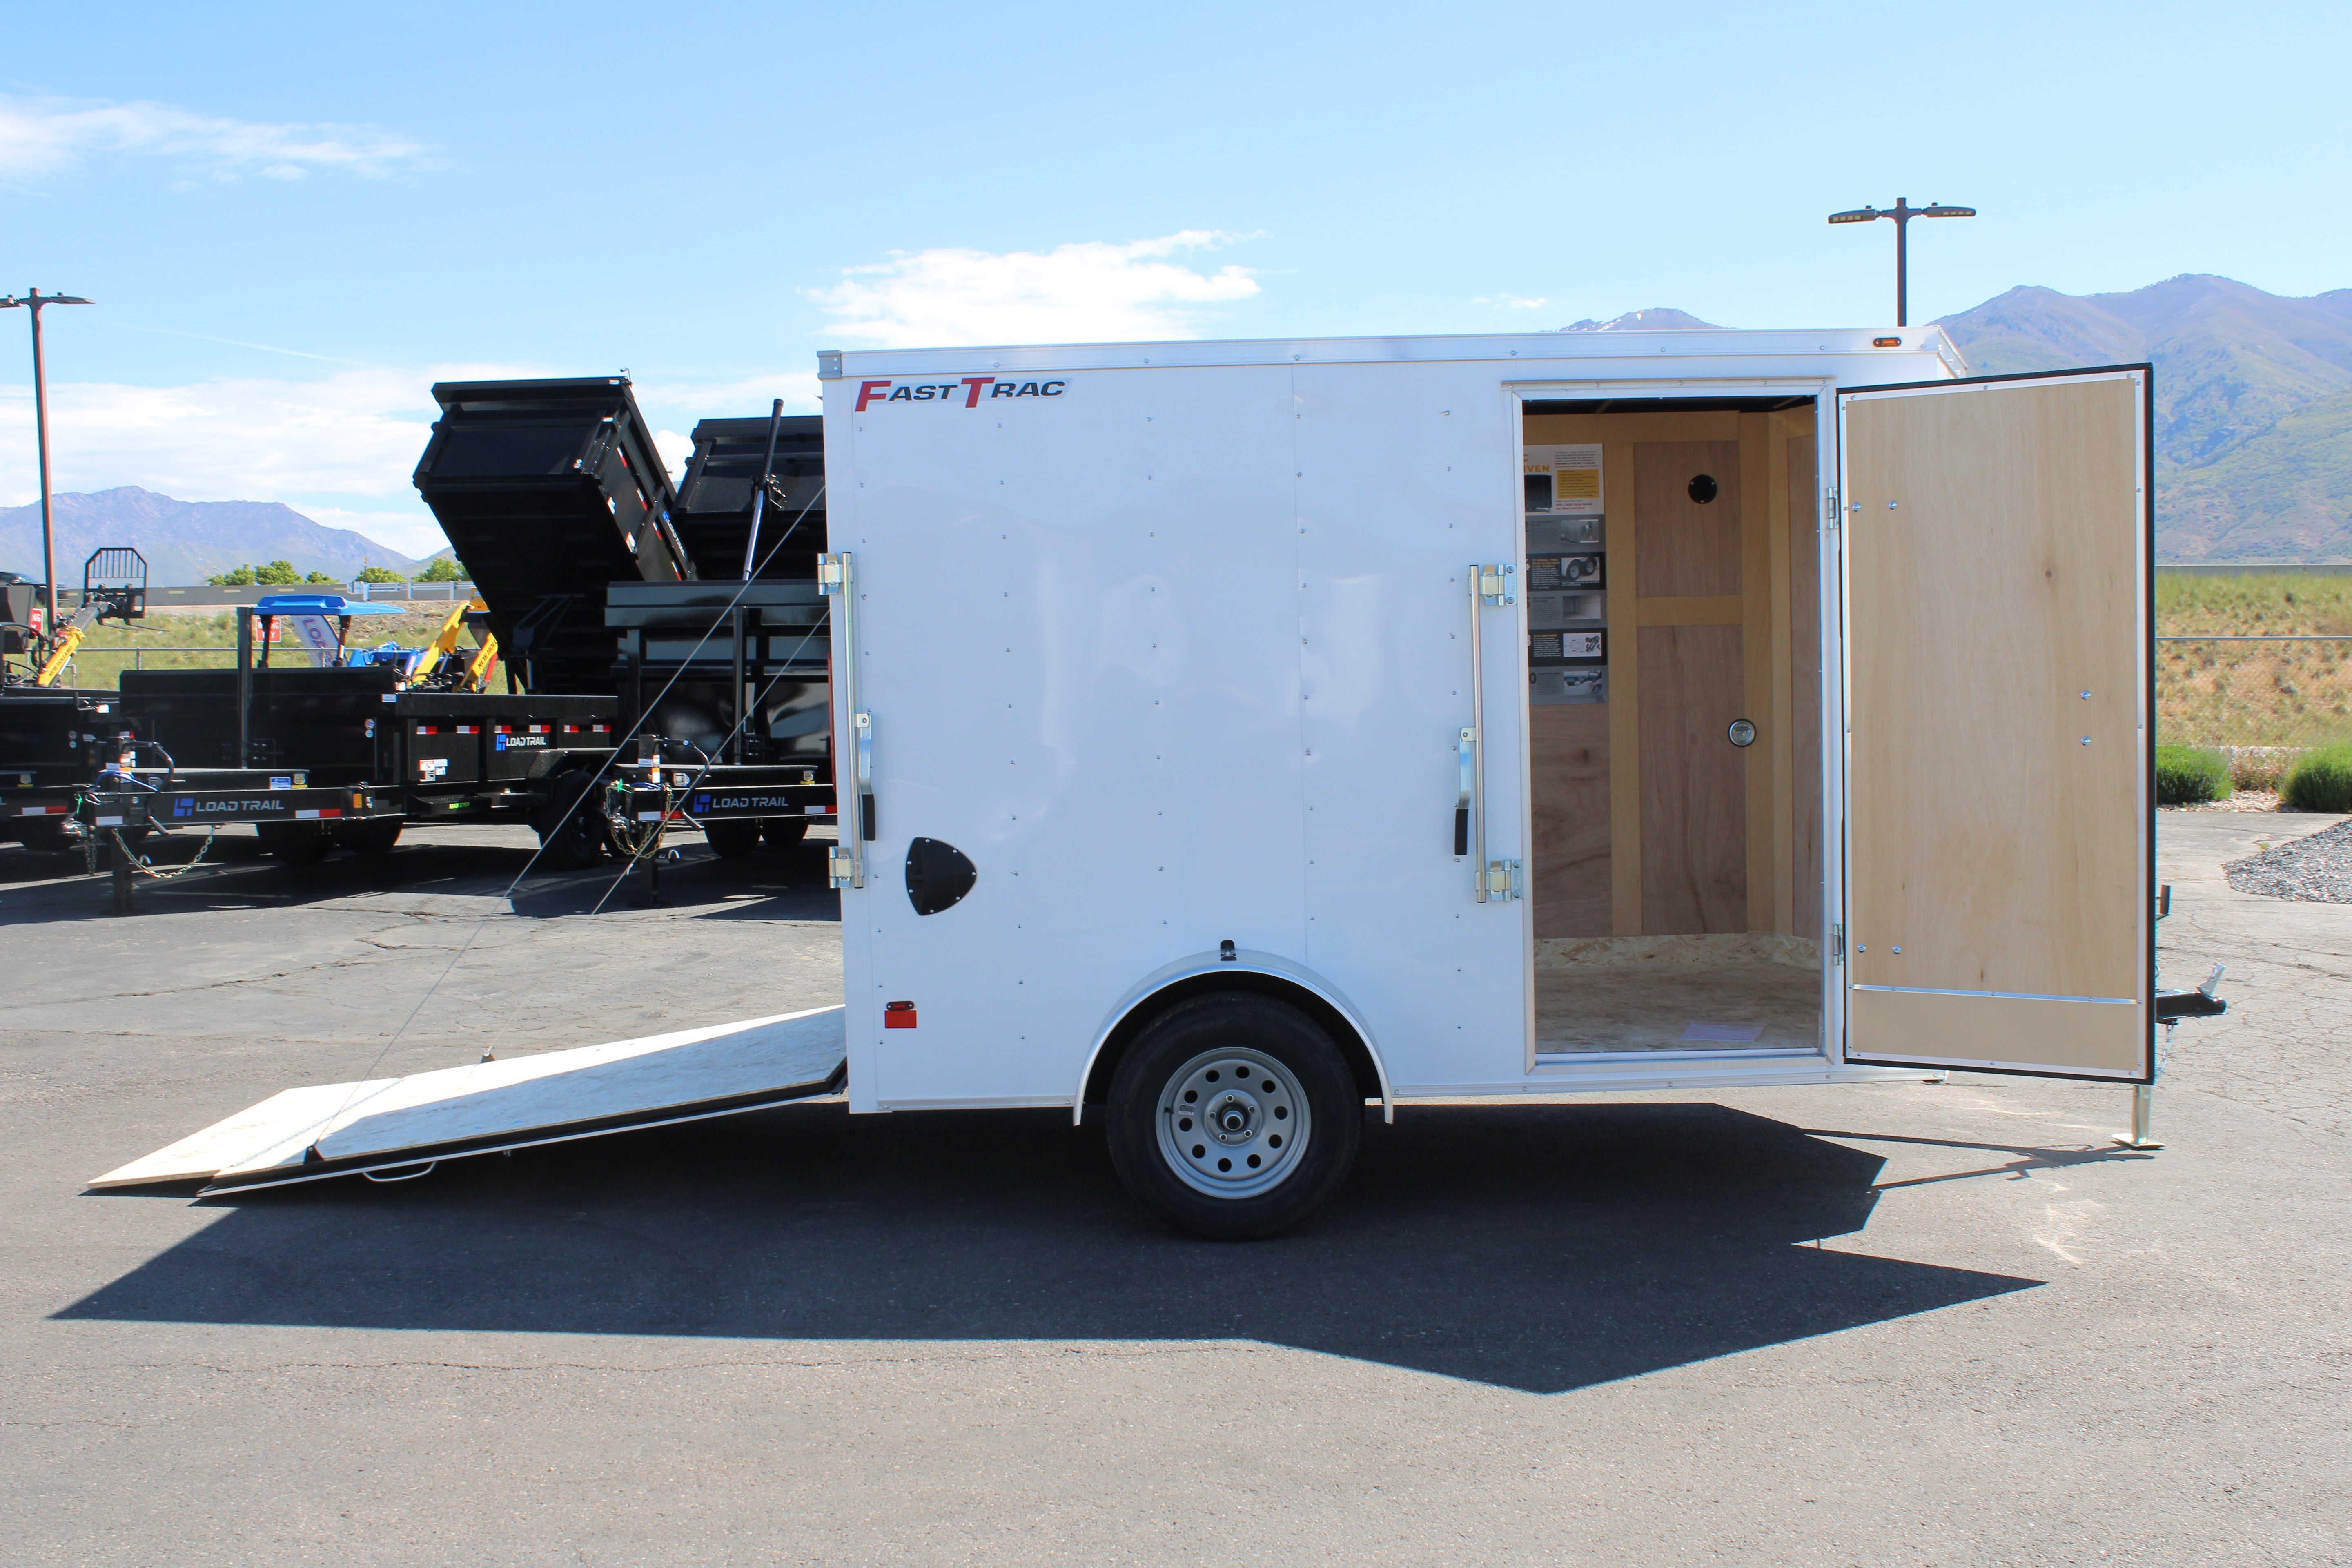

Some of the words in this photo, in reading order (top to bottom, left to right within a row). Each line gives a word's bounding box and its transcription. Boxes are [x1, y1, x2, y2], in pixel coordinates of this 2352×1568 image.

[506, 737, 526, 747] LOAD
[526, 736, 546, 746] TRAIL
[196, 801, 238, 812] LOAD
[241, 800, 285, 810] TRAIL
[713, 798, 749, 808] LOAD
[752, 797, 788, 806] TRAIL
